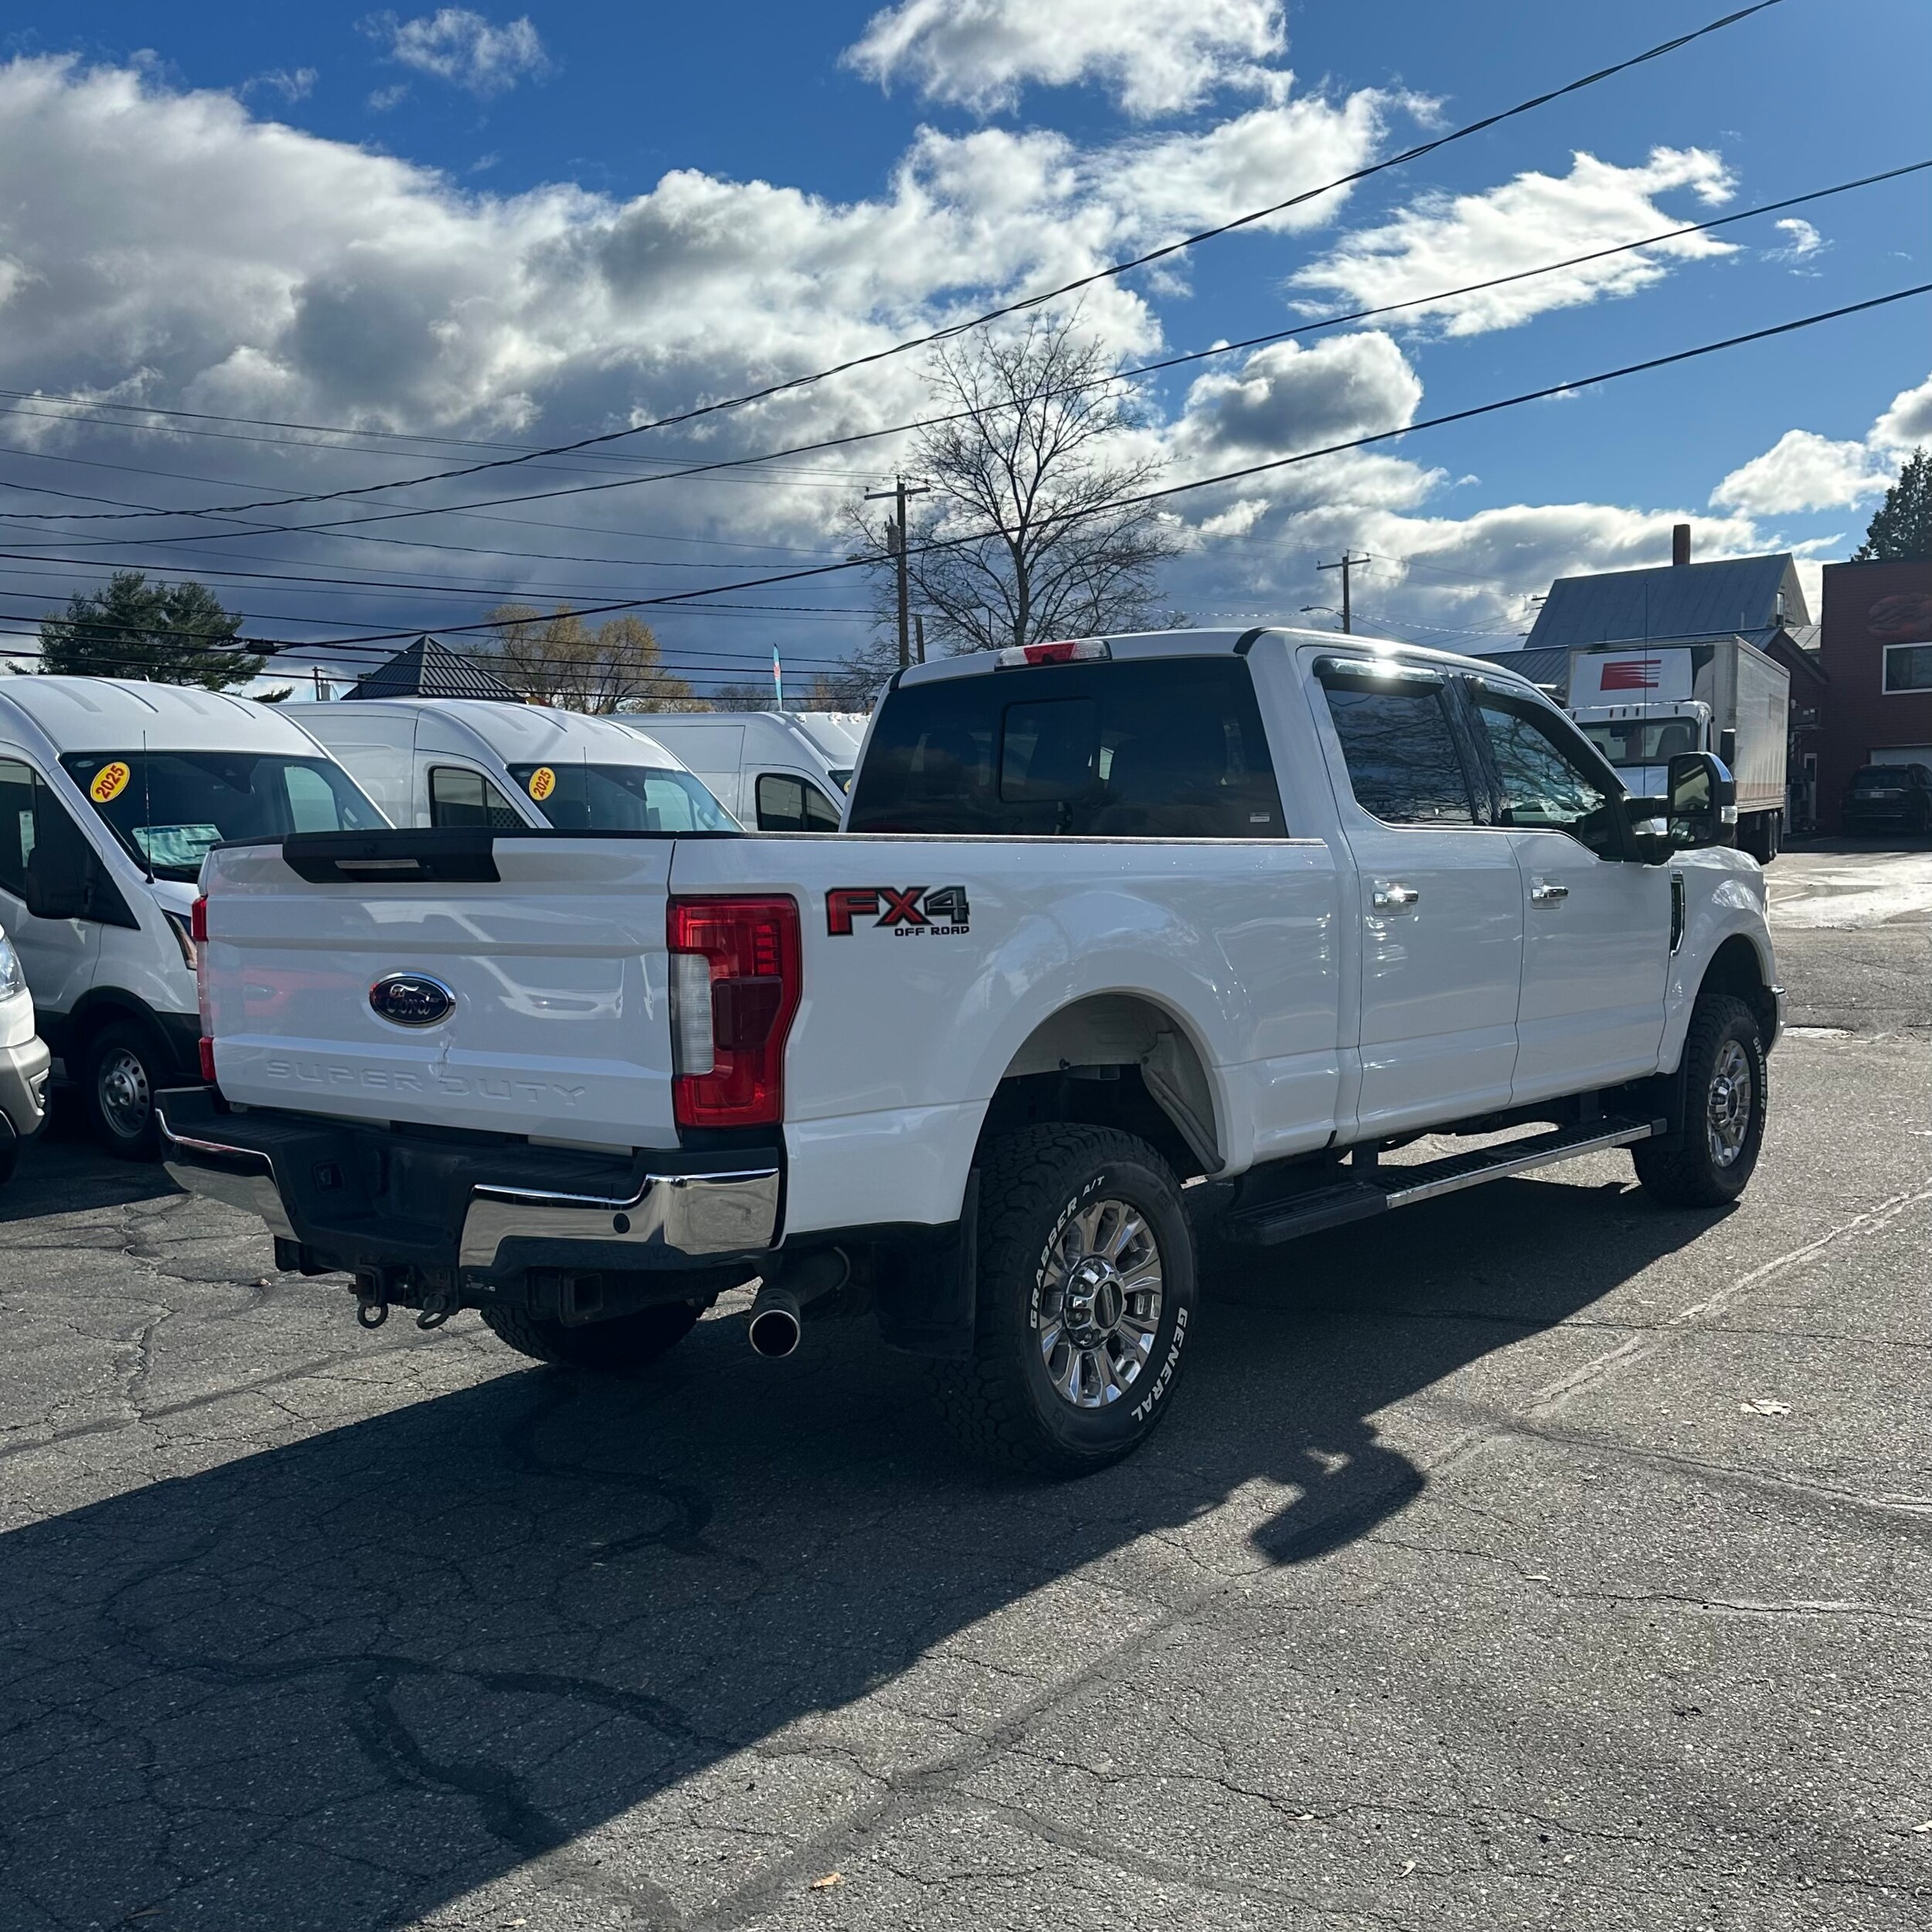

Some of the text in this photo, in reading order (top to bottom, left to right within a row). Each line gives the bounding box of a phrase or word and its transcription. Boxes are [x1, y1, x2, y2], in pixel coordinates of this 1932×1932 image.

[95, 764, 125, 799] 2025
[533, 770, 552, 798] 2025
[825, 885, 970, 937] FX4
[894, 926, 970, 937] OFF ROAD
[387, 984, 440, 1015] Ford
[267, 1060, 586, 1107] SUPER DUTY
[1030, 1175, 1105, 1329] GRABBER A/T
[1131, 1307, 1189, 1422] GENERAL
